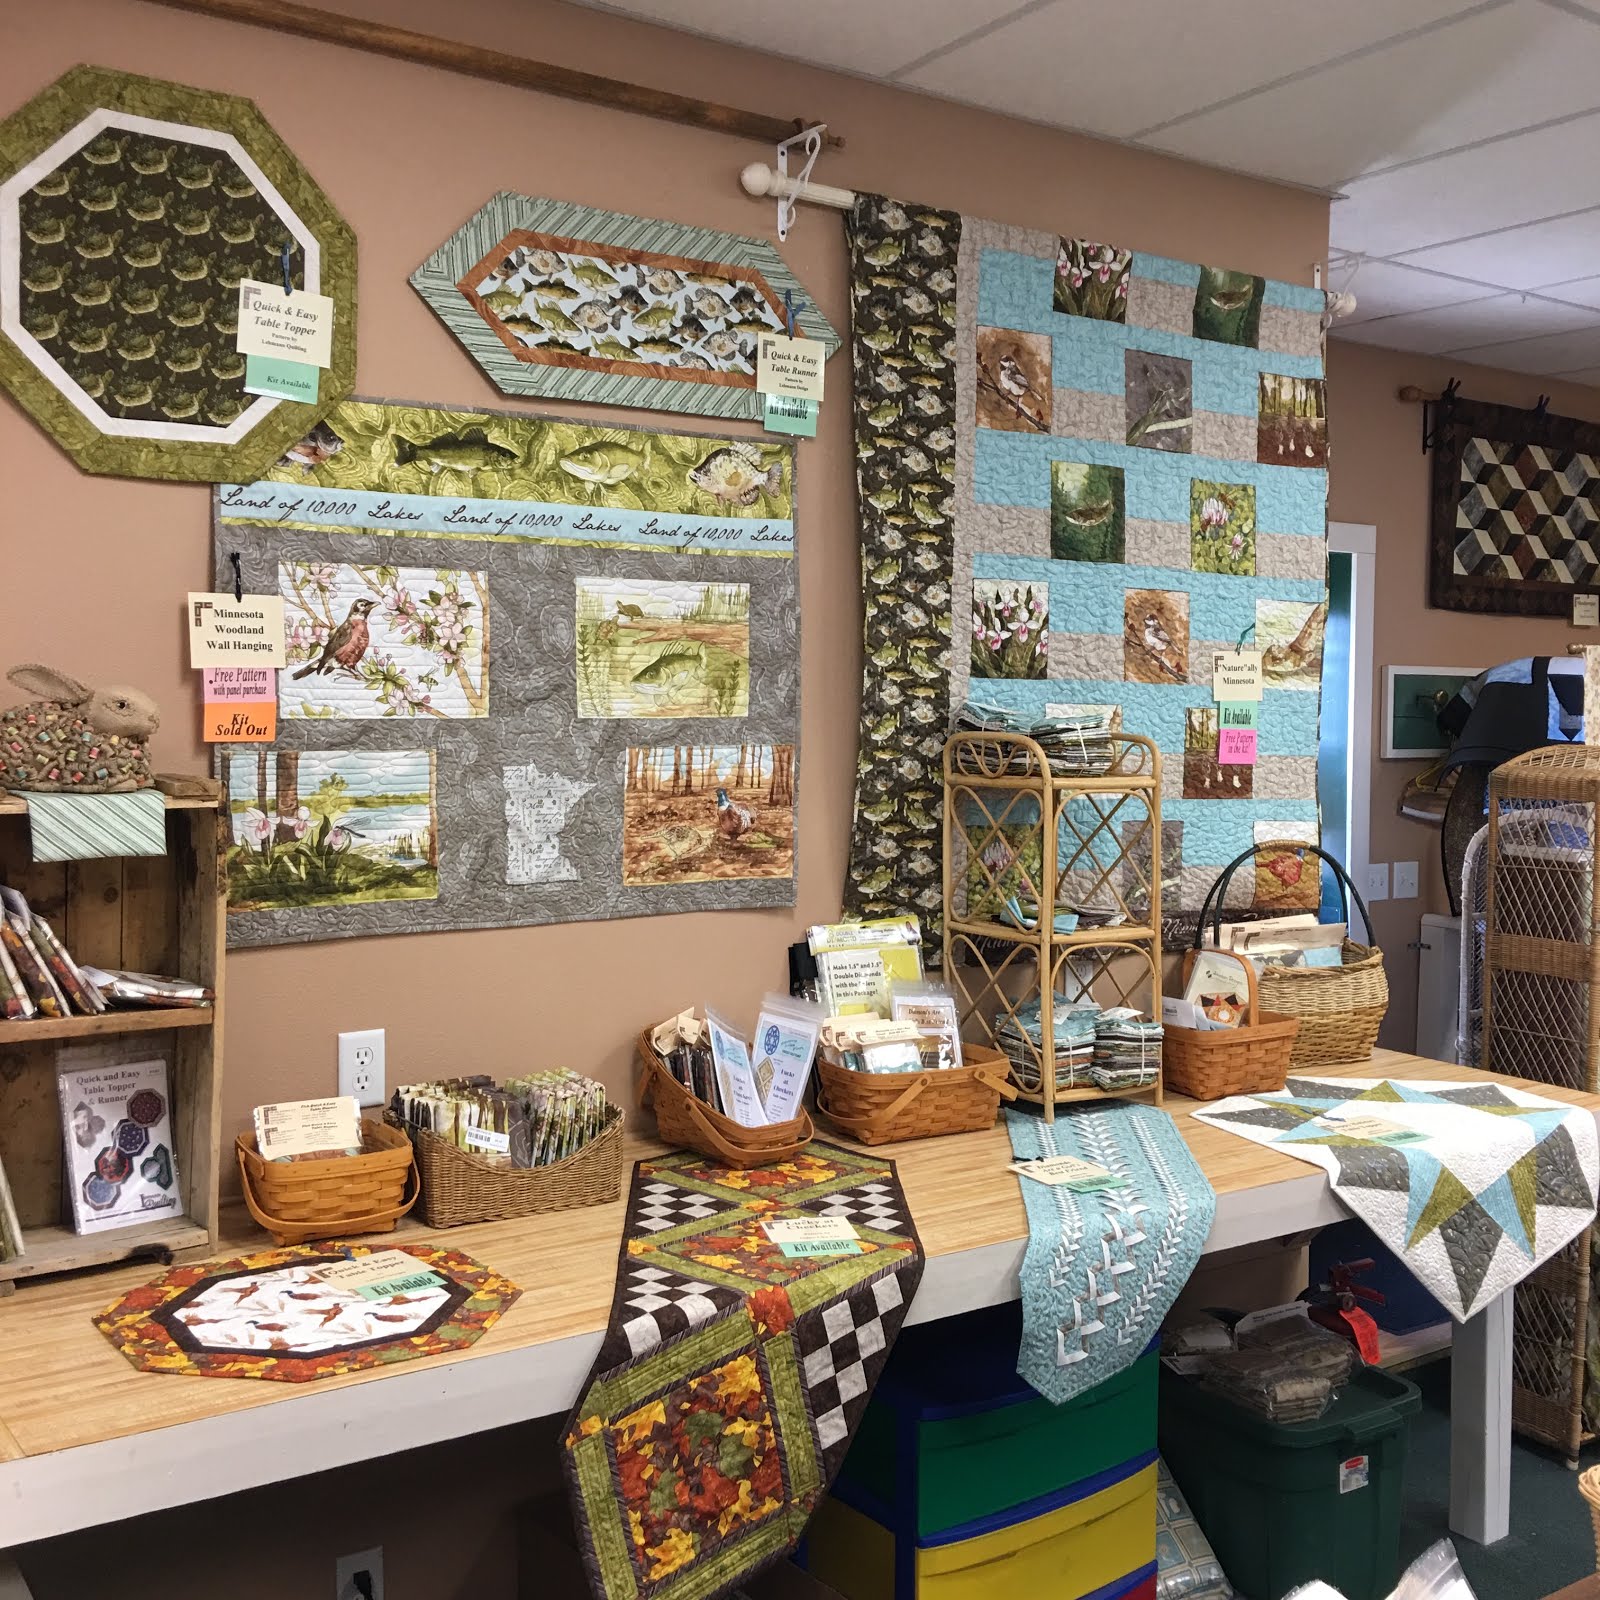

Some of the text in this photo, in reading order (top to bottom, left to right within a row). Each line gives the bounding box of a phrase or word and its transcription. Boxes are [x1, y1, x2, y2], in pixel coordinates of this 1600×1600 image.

[253, 301, 318, 322] Quick & Easy
[255, 316, 316, 336] Table Topper
[770, 351, 818, 366] Quick & Easy
[771, 364, 818, 377] Table Runner
[266, 376, 312, 389] Kit Available
[220, 487, 424, 522] Land of 10,000 Lakes
[444, 504, 622, 536] Land of 10,000 Lakes
[638, 518, 794, 548] Land of 10,000 Lakes
[214, 609, 264, 619] Minnesota
[214, 624, 264, 634] Woodland
[206, 640, 274, 652] Wall Hanging
[214, 668, 267, 682] Free Pattern
[1222, 677, 1255, 685] Minnesota
[213, 683, 267, 698] with panel purchase
[231, 713, 249, 725] Kit
[215, 724, 268, 736] Sold Out
[76, 1075, 102, 1085] Quick
[104, 1071, 119, 1081] and
[121, 1070, 141, 1081] Easy
[83, 1082, 136, 1095] Table Topper
[98, 1094, 127, 1104] Runner
[793, 1242, 851, 1252] Kit Available
[328, 1264, 359, 1276] Quick
[370, 1260, 404, 1271] Topper
[371, 1285, 390, 1296] Kit
[391, 1276, 436, 1292] Available
